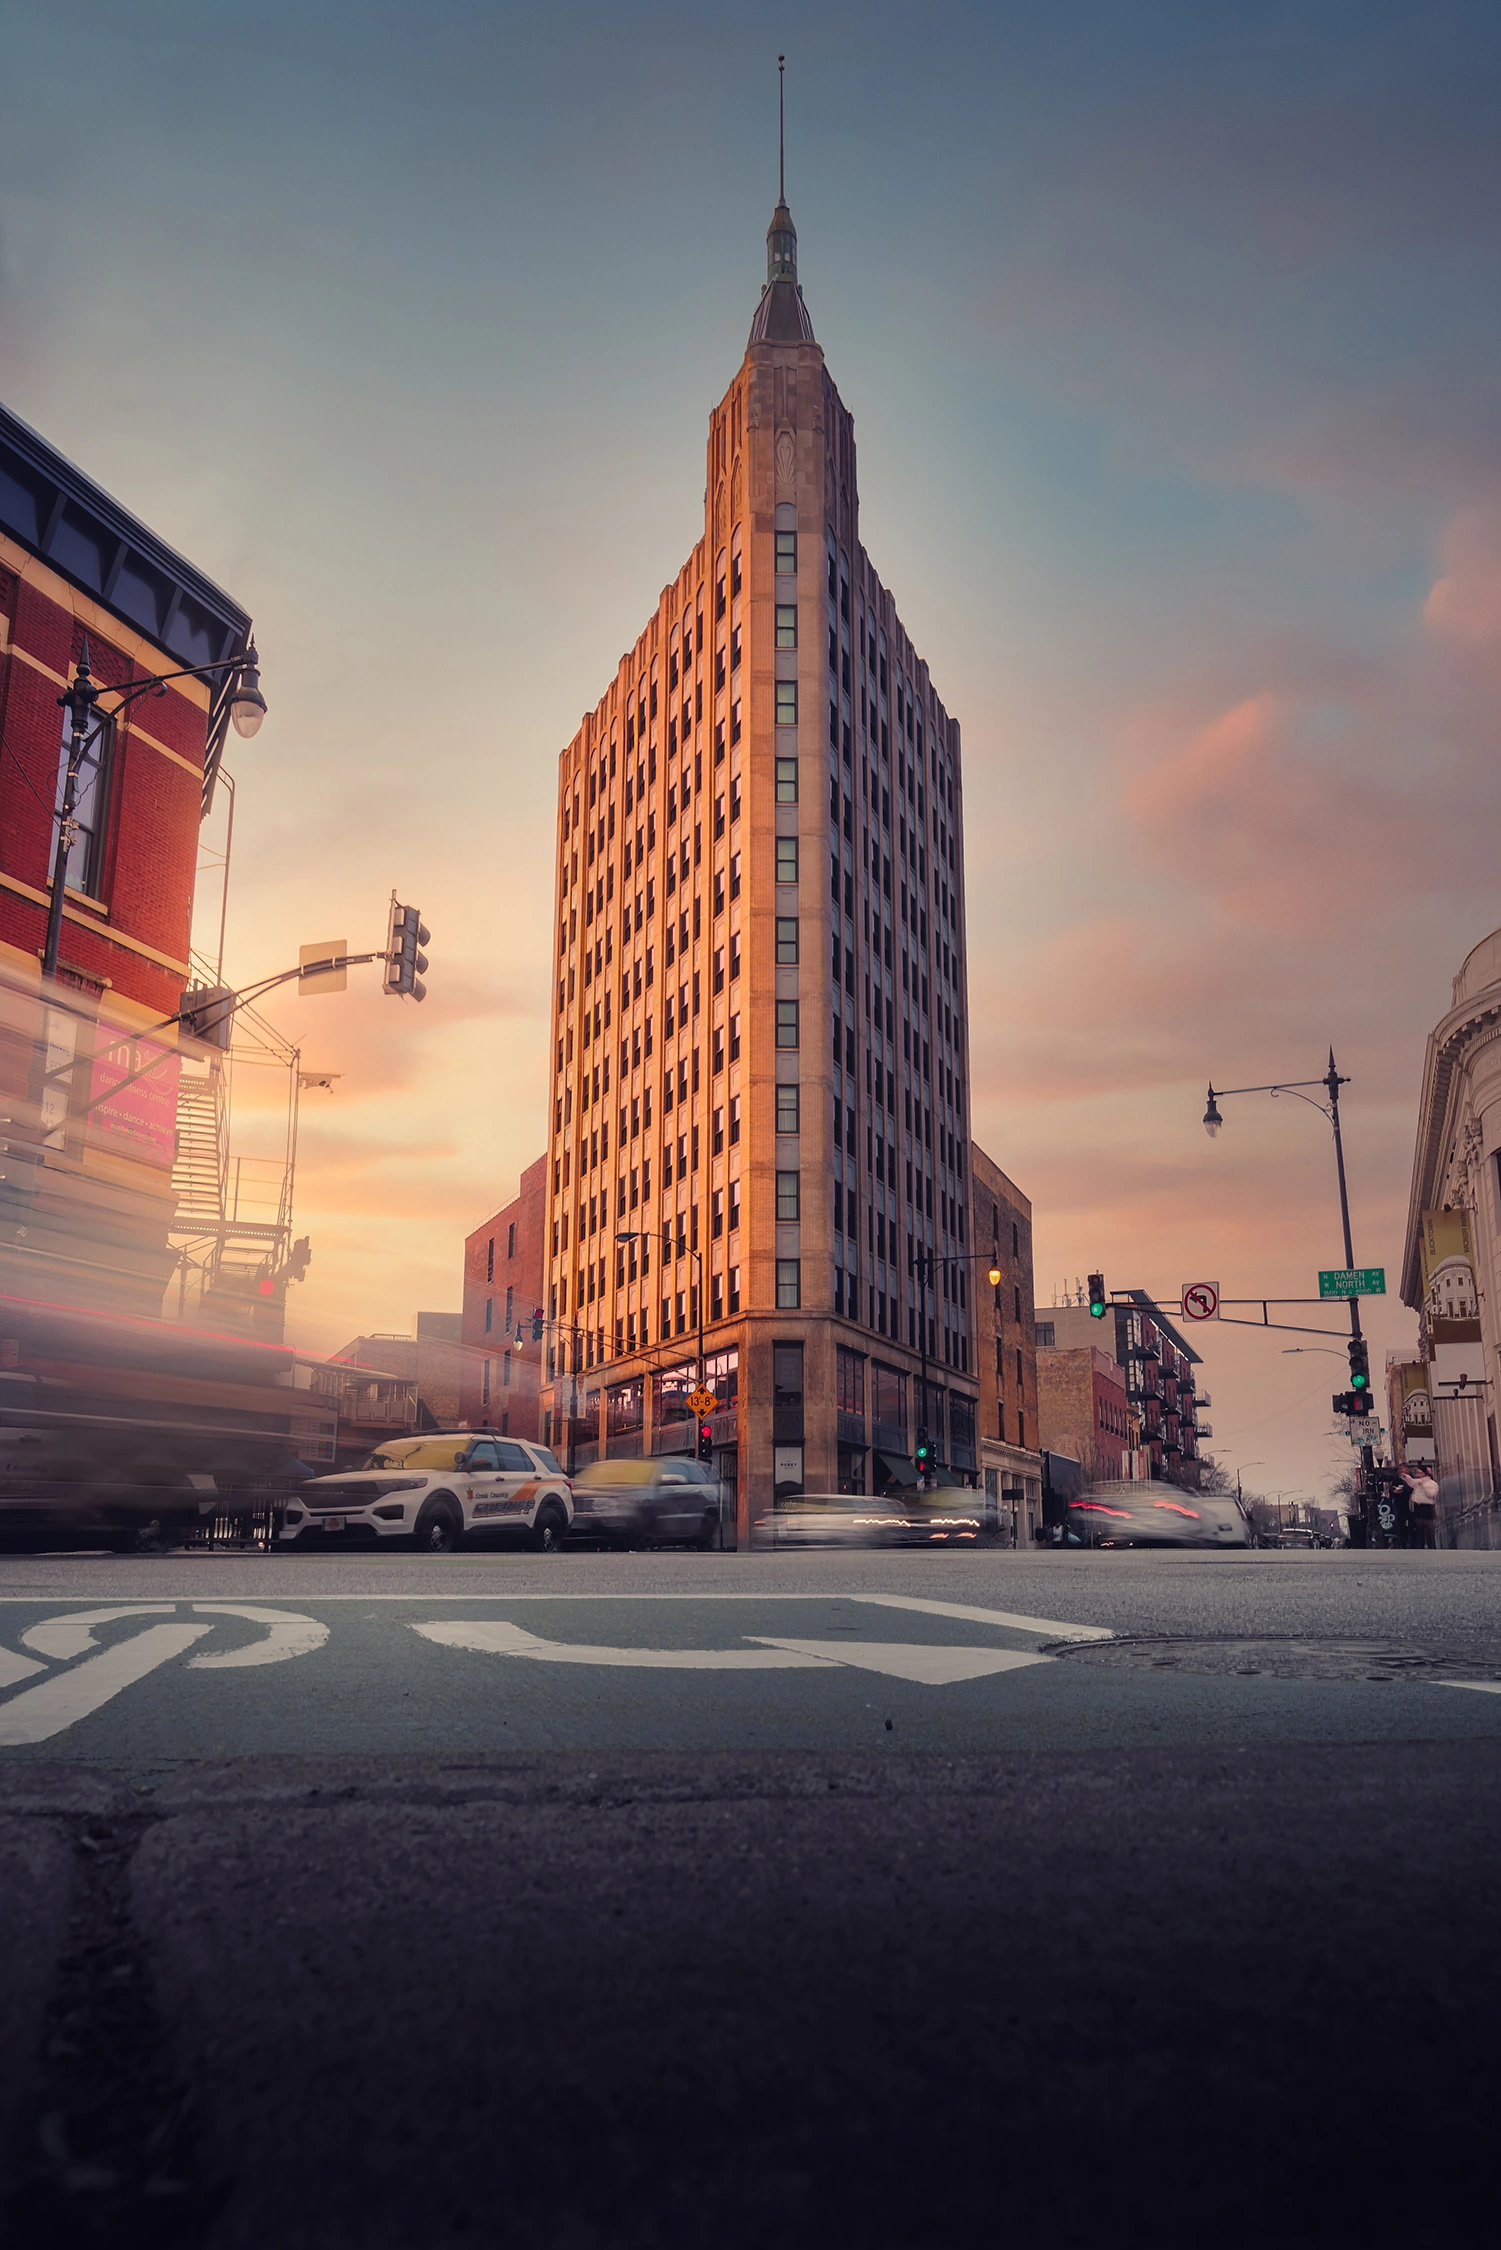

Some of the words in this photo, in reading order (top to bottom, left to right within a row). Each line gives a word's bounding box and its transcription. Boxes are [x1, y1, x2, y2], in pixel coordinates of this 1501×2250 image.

[124, 1083, 148, 1098] itness
[149, 1091, 171, 1107] centre
[94, 1103, 118, 1117] nspire
[123, 1111, 144, 1126] dance
[149, 1120, 174, 1137] achieve
[1427, 1218, 1436, 1256] BUCKTOWN
[1462, 1227, 1470, 1254] WICKER
[1333, 1270, 1365, 1280] DAMEN
[1335, 1280, 1365, 1289] NORTH
[490, 1491, 509, 1499] County
